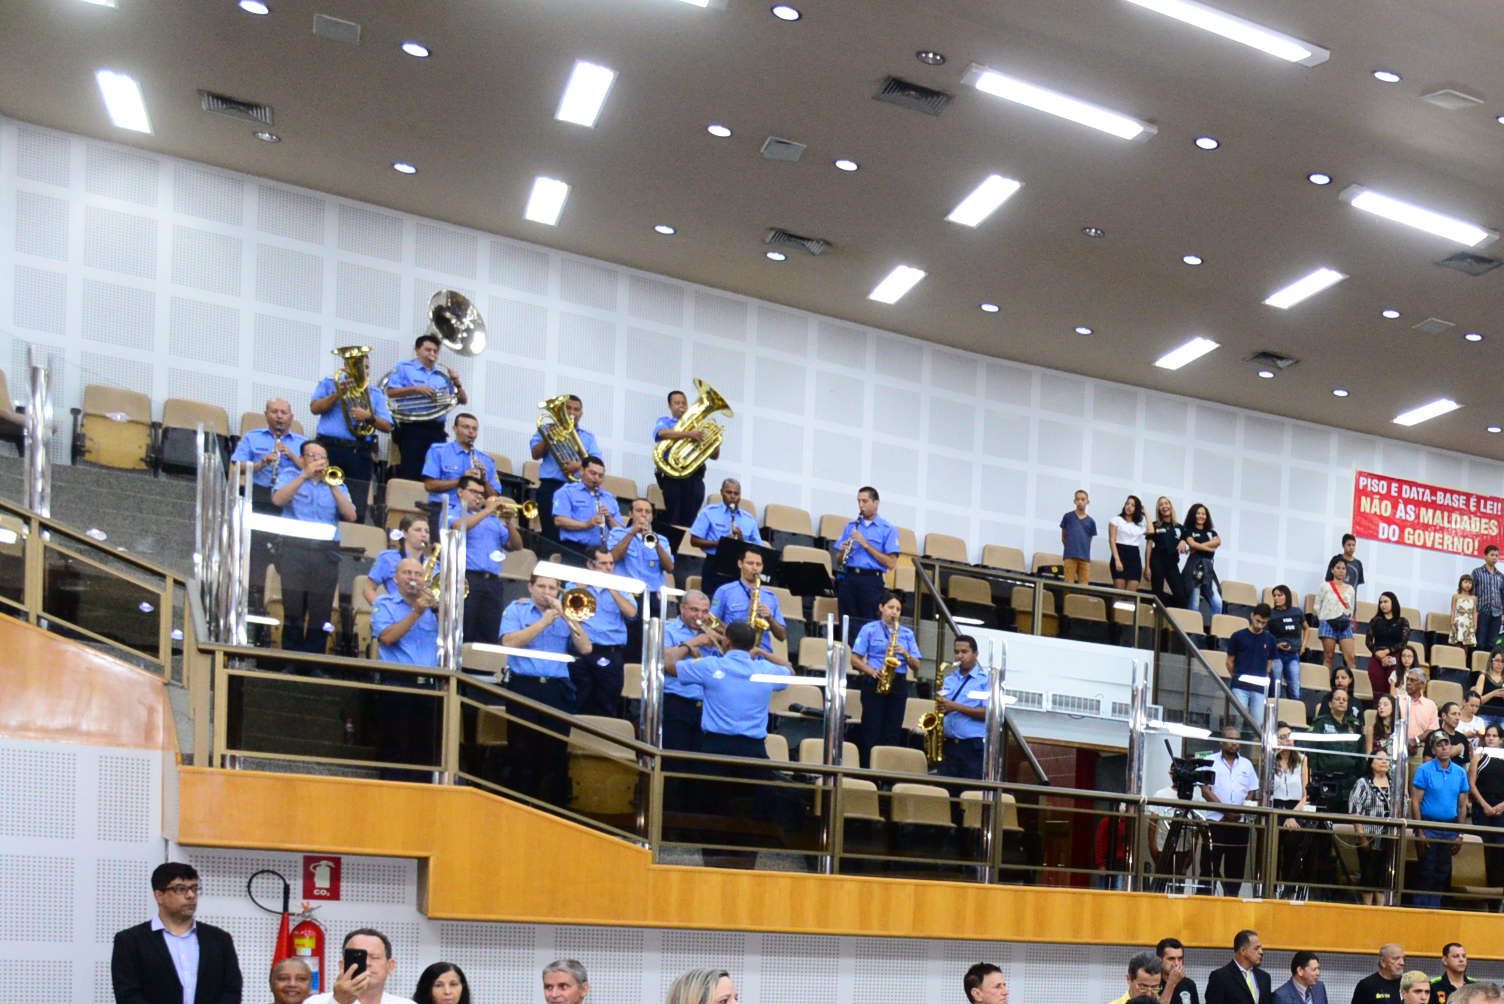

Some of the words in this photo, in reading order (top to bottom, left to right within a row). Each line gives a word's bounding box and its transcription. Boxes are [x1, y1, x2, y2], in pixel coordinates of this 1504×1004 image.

[1359, 476, 1387, 494] PISO
[1391, 482, 1399, 496] E
[1402, 484, 1466, 509] DATA-BASE
[1480, 499, 1502, 515] LEI!
[1361, 495, 1392, 517] NÃO
[1395, 499, 1416, 521] ÀS
[1420, 507, 1499, 536] MALDADES
[1378, 522, 1399, 541] DO
[1404, 527, 1479, 555] GOVERNO!
